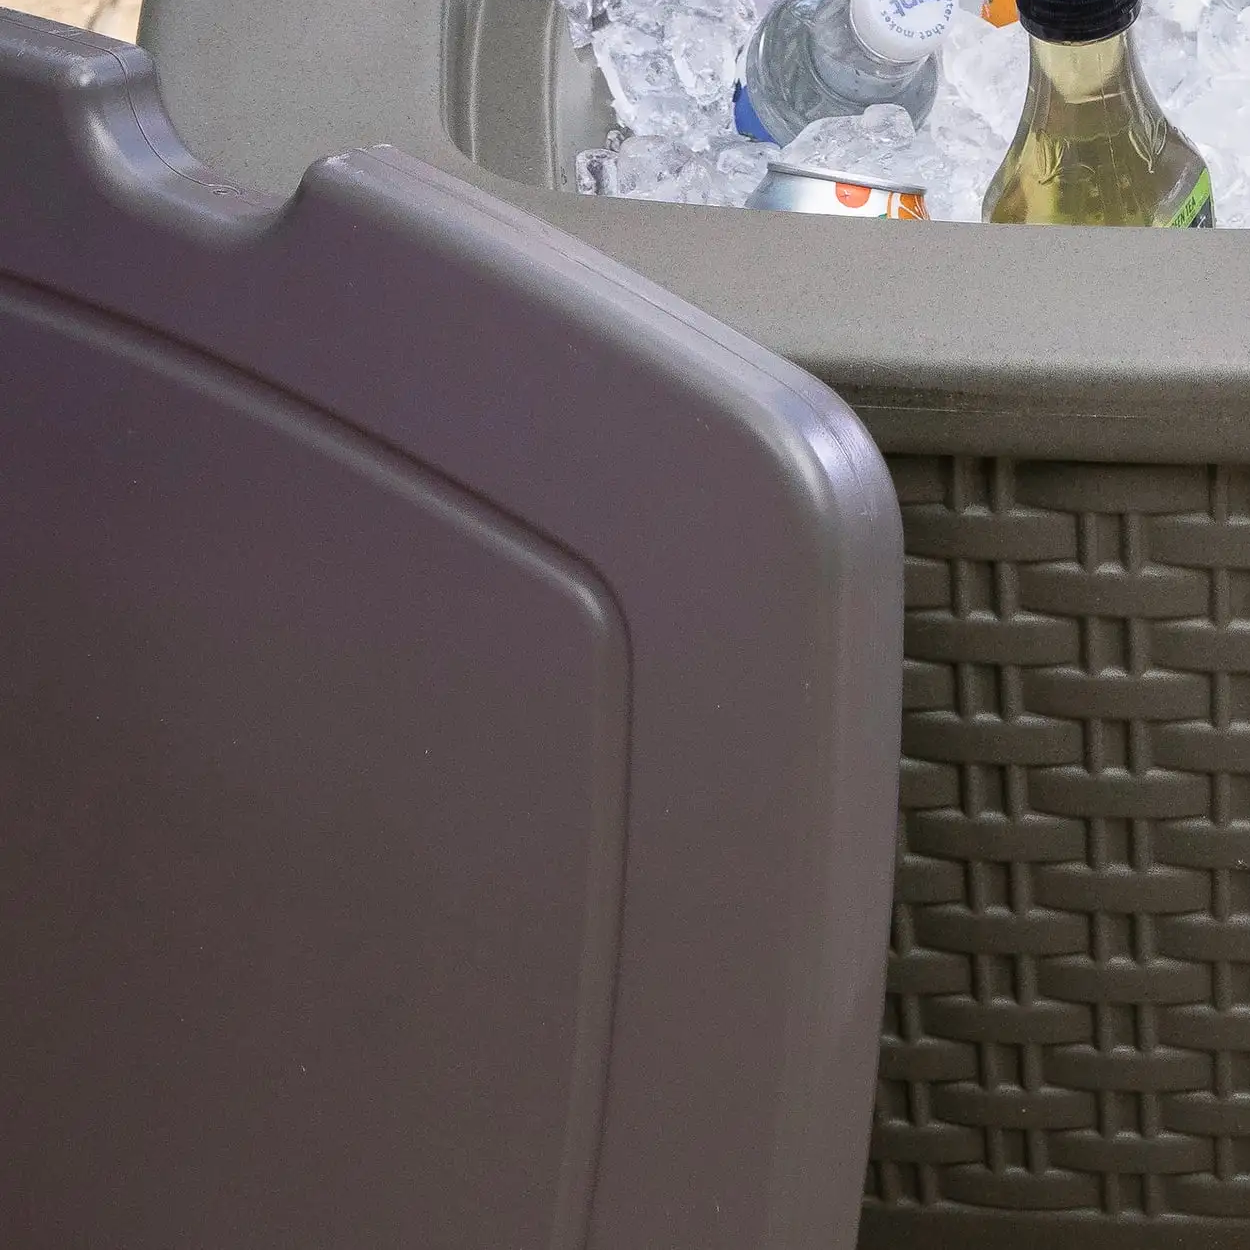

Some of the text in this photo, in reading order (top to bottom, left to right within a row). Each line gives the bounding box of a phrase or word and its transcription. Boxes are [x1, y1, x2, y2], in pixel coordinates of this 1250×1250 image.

[880, 10, 915, 38] makes
[919, 22, 945, 40] that
[1185, 196, 1196, 216] TEA
